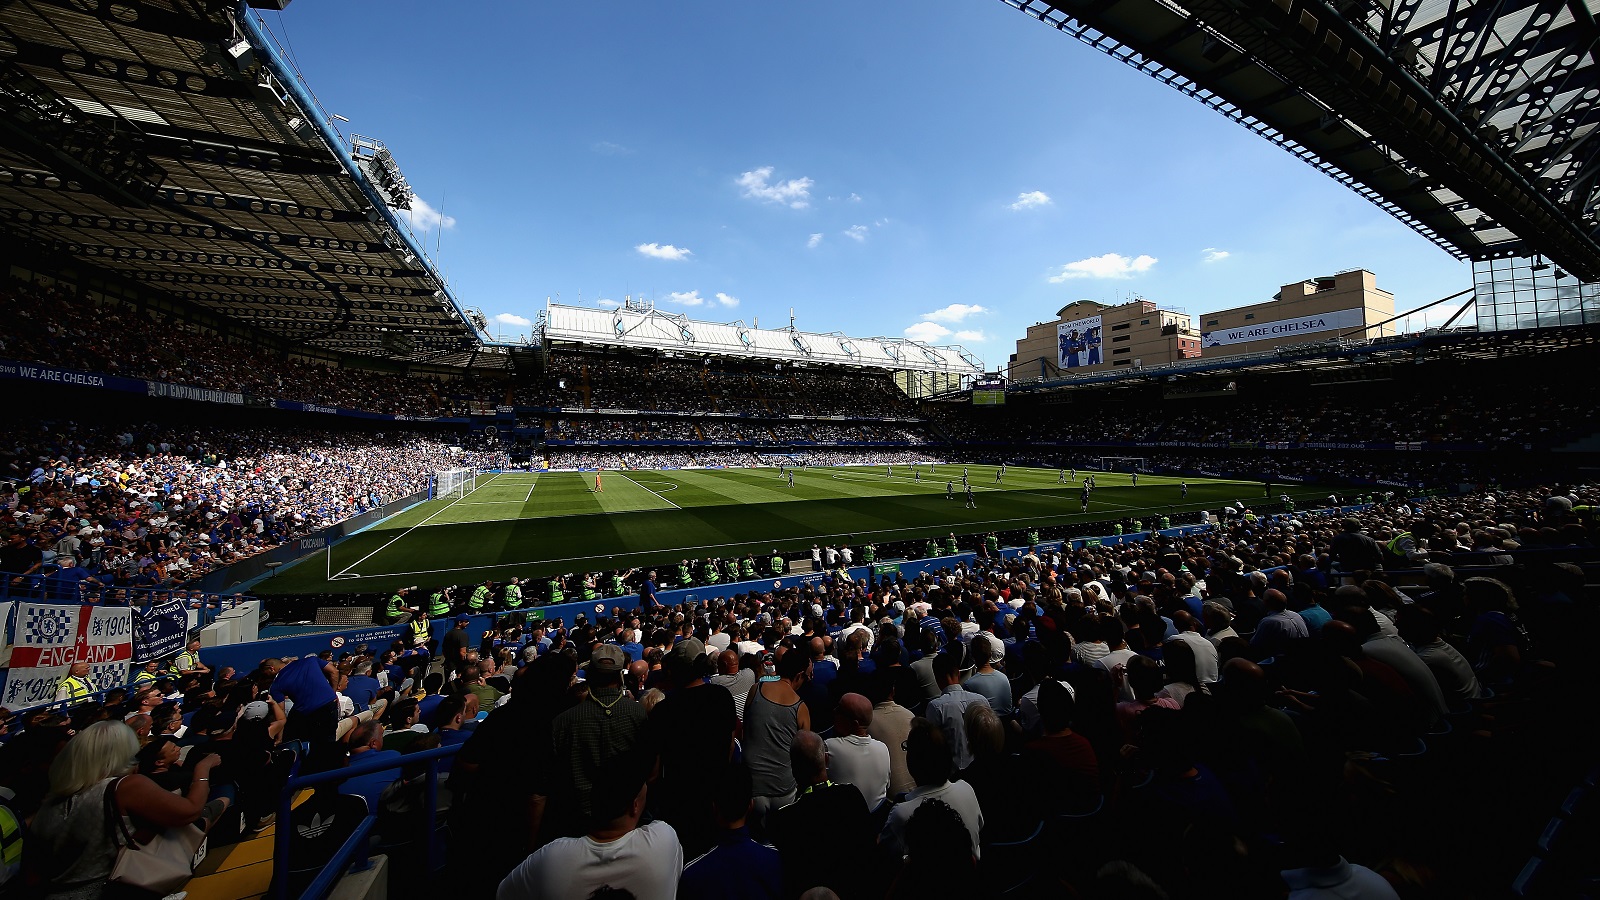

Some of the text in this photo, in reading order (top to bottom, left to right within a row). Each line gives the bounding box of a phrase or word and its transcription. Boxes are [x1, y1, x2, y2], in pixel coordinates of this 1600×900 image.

[1228, 319, 1326, 340] WE ARE CHELSEA
[20, 366, 38, 379] WE
[39, 369, 62, 382] ARE
[62, 372, 105, 387] CHELSEA
[158, 383, 168, 396] JT
[36, 645, 116, 667] ENGLAND
[24, 675, 62, 703] 1905
